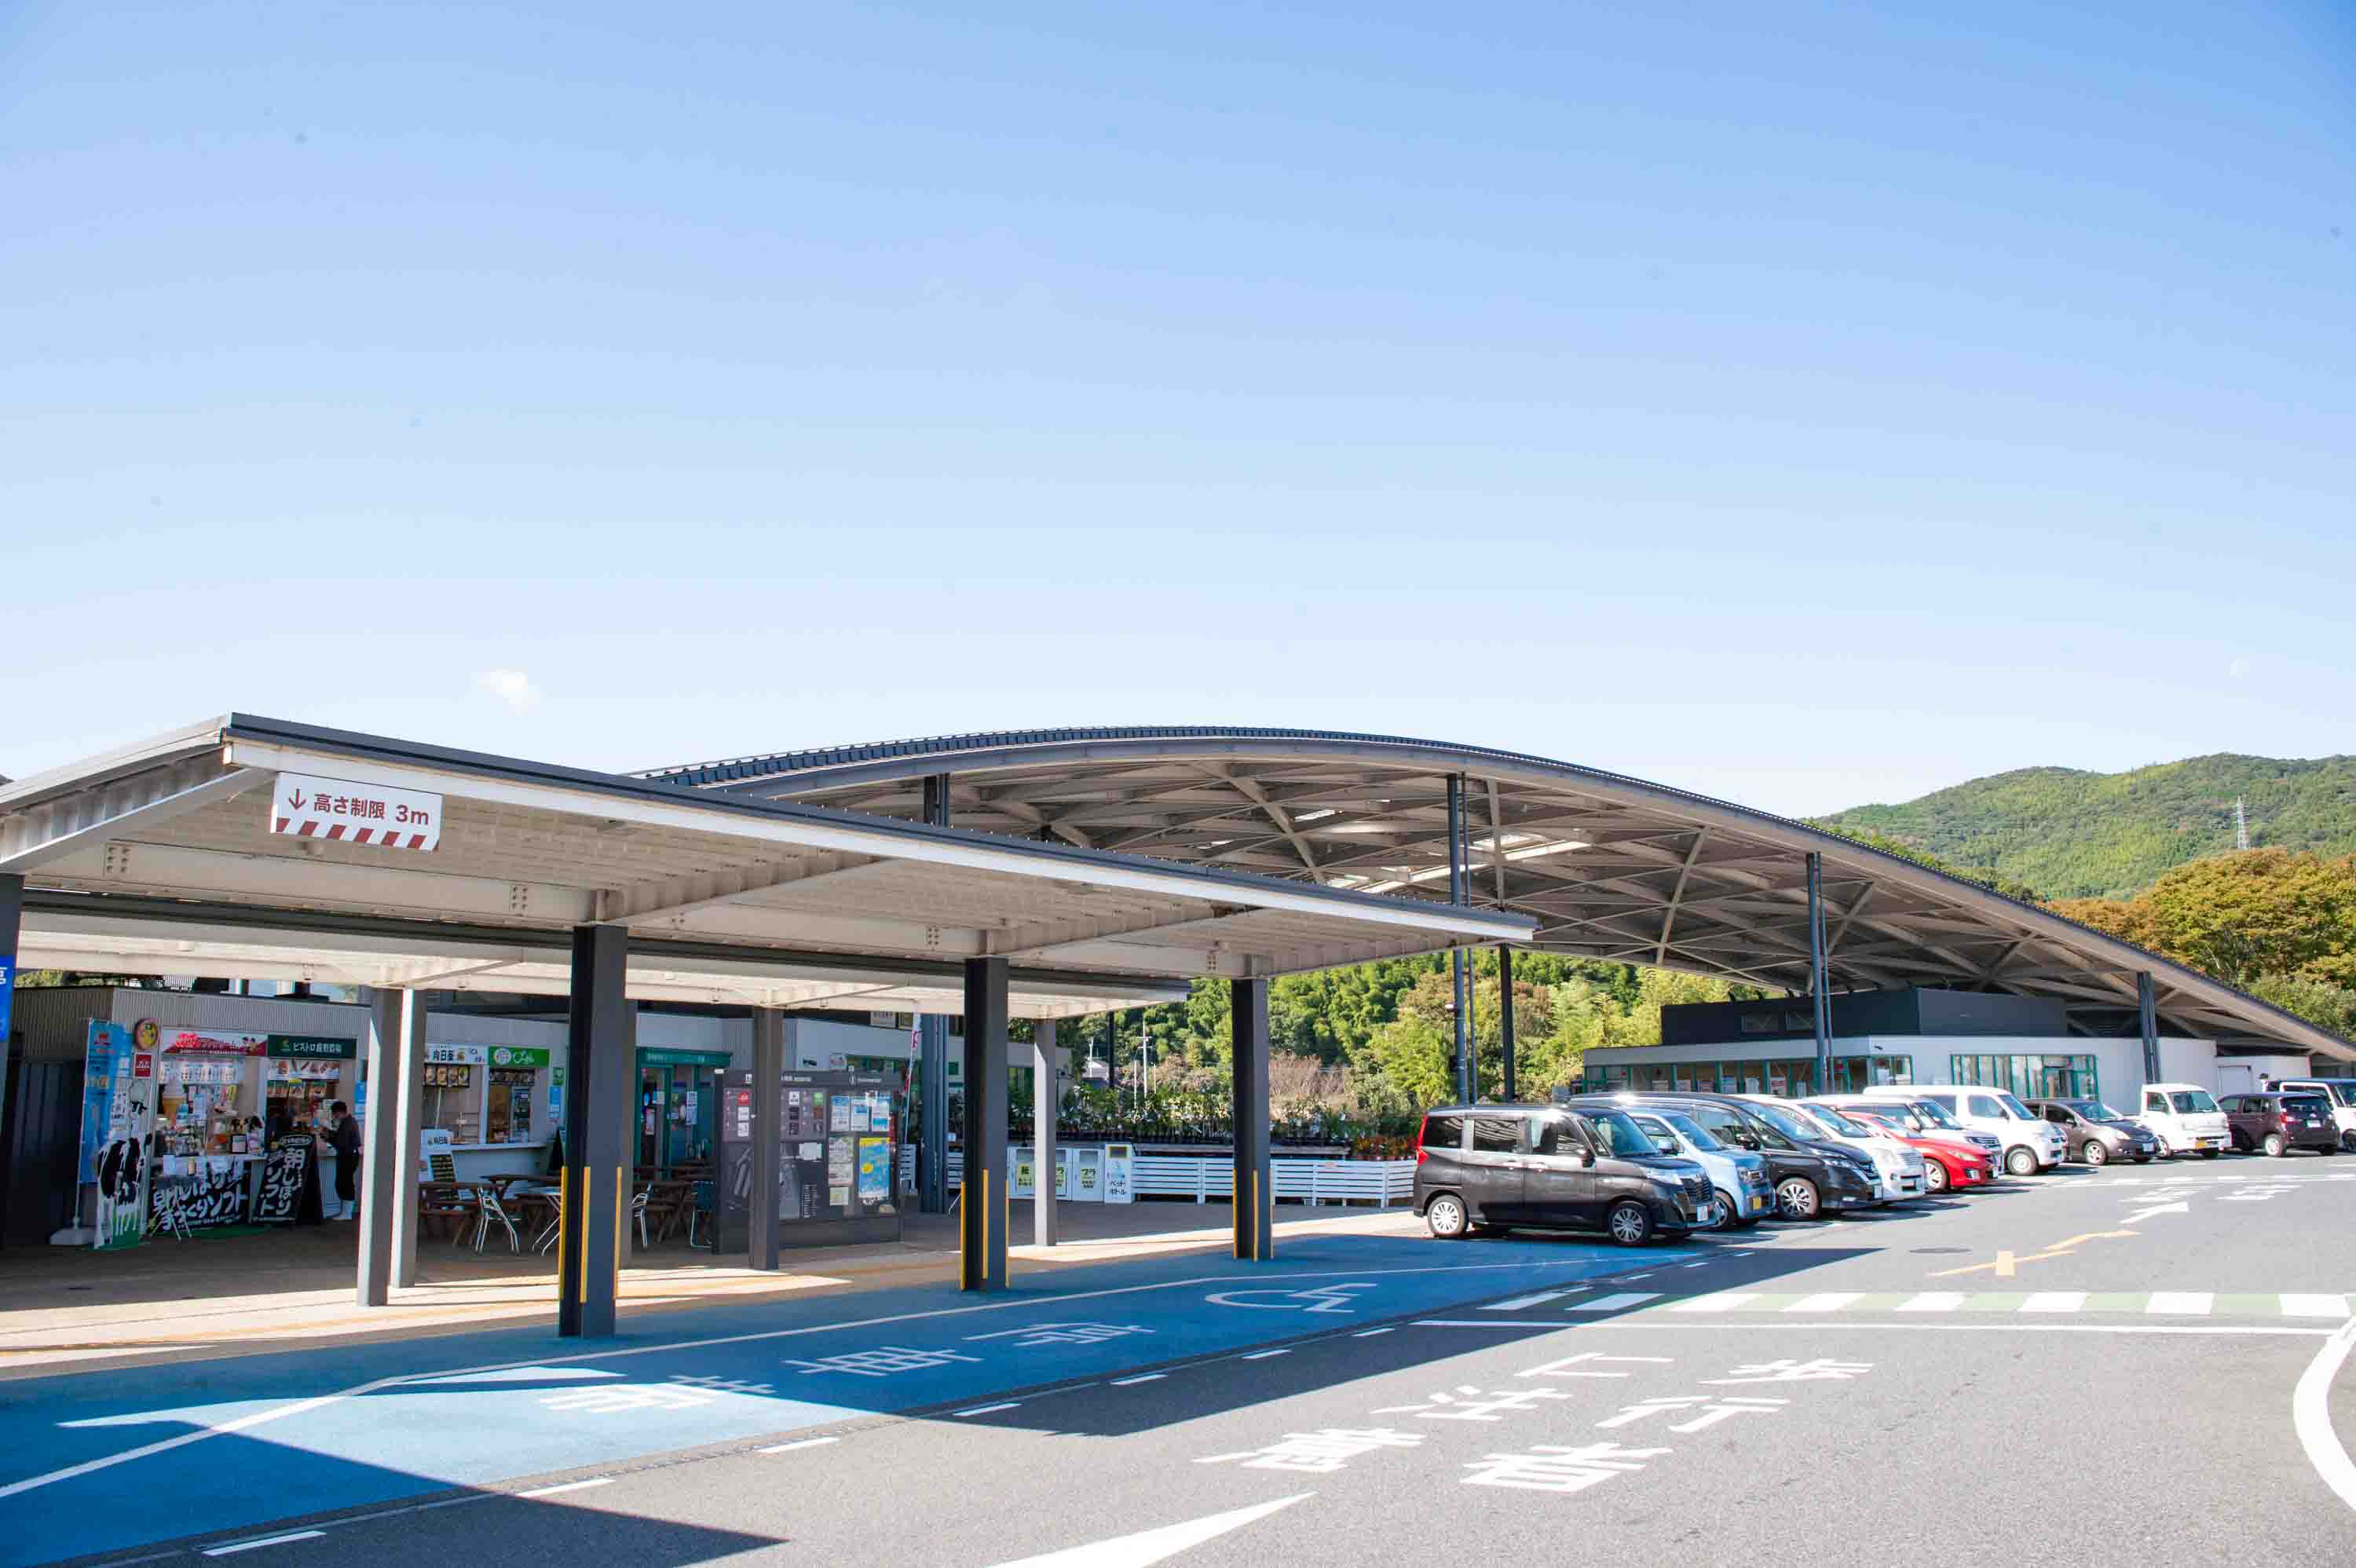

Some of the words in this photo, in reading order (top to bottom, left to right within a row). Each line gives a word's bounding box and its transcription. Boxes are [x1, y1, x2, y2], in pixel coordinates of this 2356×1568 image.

[314, 793, 386, 819] 高さ制限
[396, 804, 430, 825] 3m
[1459, 1358, 1875, 1492] 歩行者
